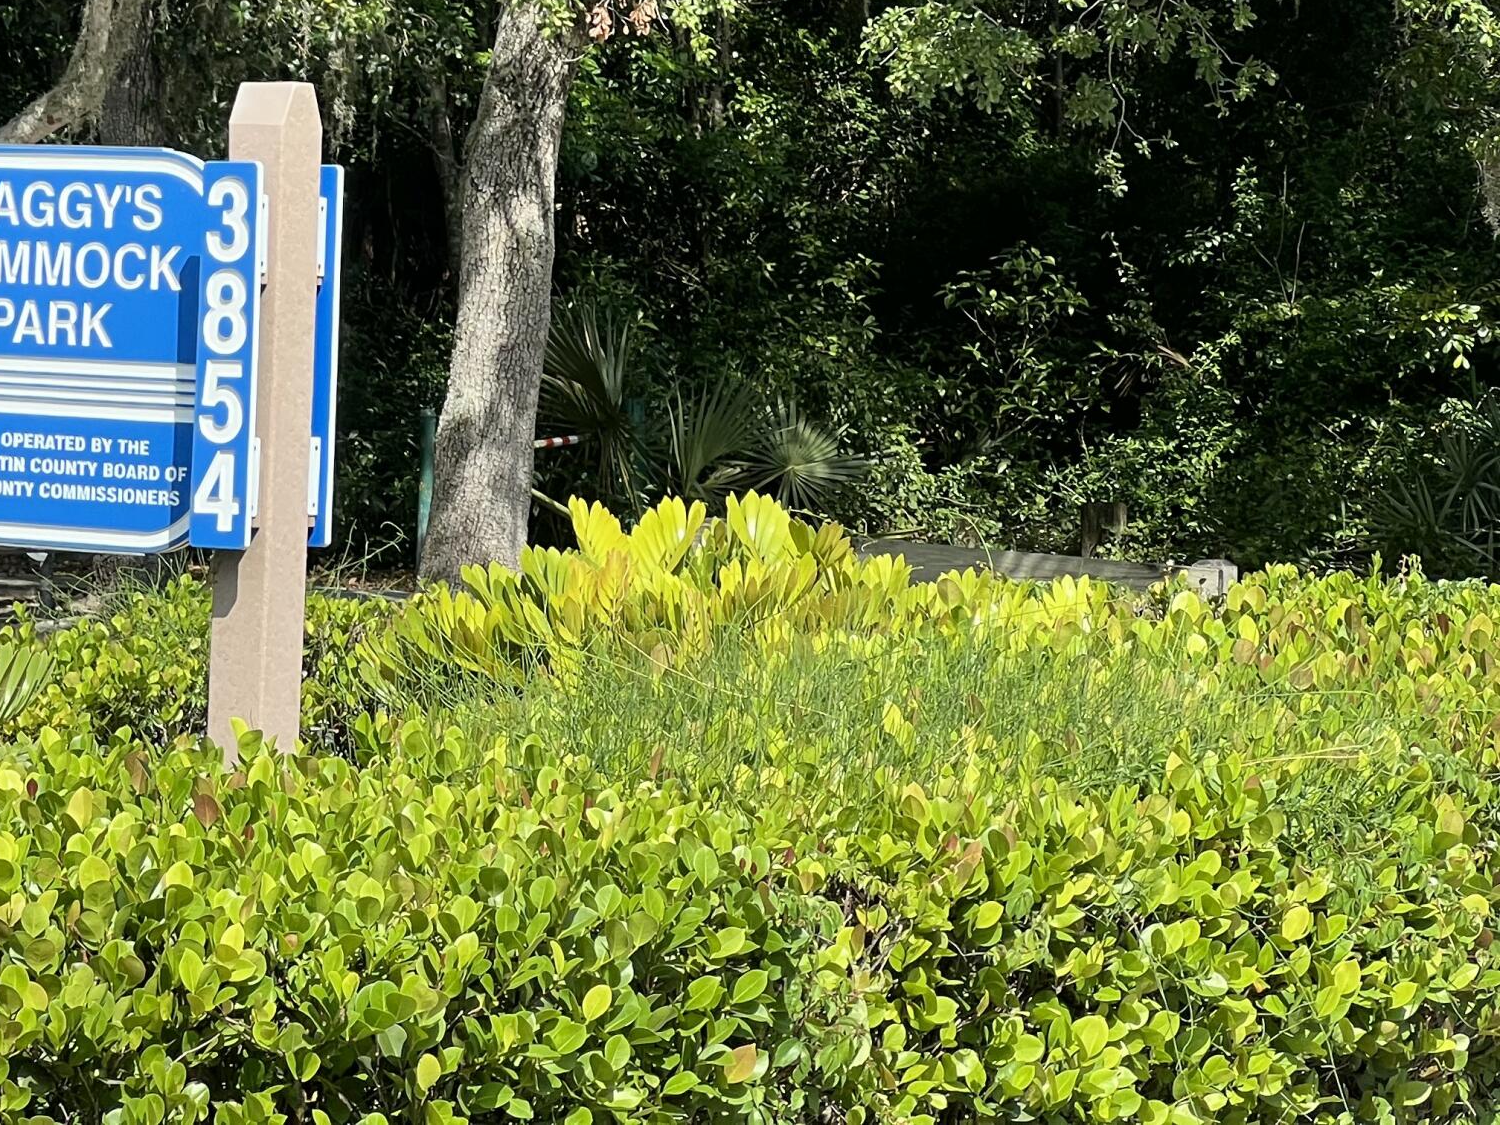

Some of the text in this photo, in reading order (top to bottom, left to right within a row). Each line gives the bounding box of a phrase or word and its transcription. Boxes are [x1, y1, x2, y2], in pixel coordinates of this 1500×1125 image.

[194, 178, 249, 531] 3854
[0, 432, 150, 456] OPERATED BY THE
[30, 457, 98, 477] COUNTY
[103, 463, 159, 481] BOARD
[164, 466, 187, 483] OF
[39, 483, 180, 506] COMMISSIONERS
